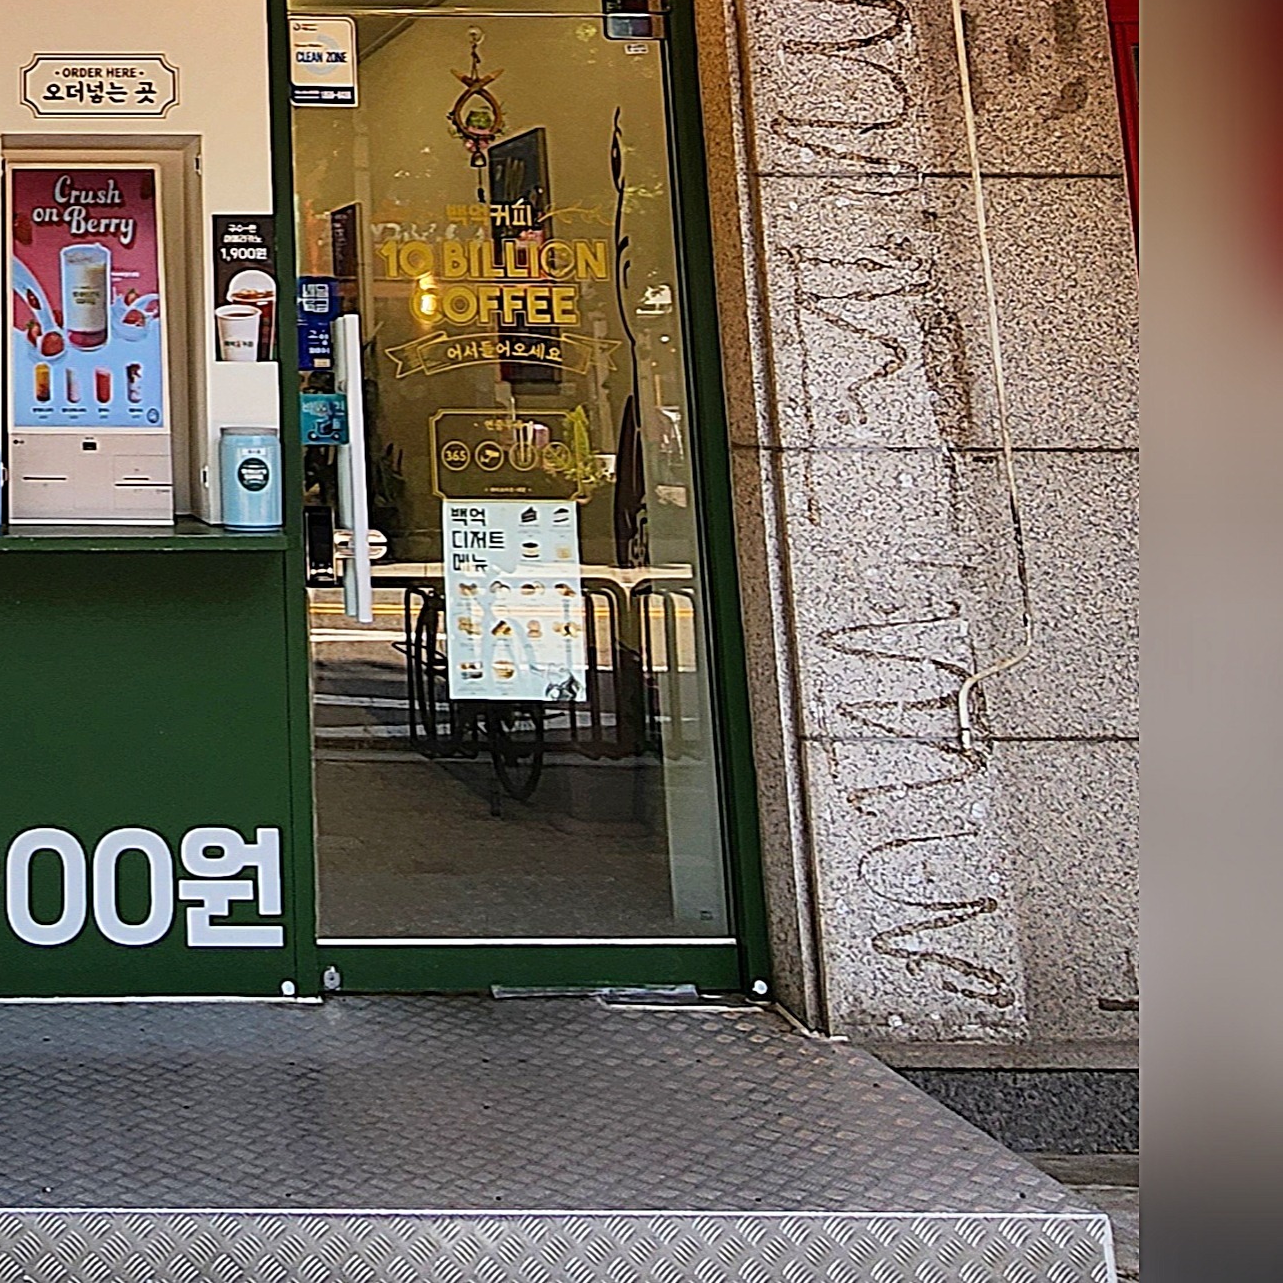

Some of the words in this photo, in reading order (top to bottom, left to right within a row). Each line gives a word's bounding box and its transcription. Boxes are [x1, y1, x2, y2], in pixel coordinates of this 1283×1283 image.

[62, 68, 103, 78] ORDER
[106, 68, 137, 78] HERE
[42, 81, 128, 104] 오더넣는
[135, 81, 157, 104] 곳
[54, 175, 122, 203] Crush
[32, 207, 59, 222] on
[63, 205, 134, 244] Berry
[446, 204, 532, 226] 백억커피
[220, 247, 268, 262] 1,900원
[378, 239, 435, 279] 10
[441, 238, 608, 279] BILLION
[410, 285, 579, 324] COFFEE
[445, 450, 467, 462] 365
[450, 507, 486, 526] 백억
[452, 530, 505, 549] 디저트
[453, 553, 488, 571] 메뉴
